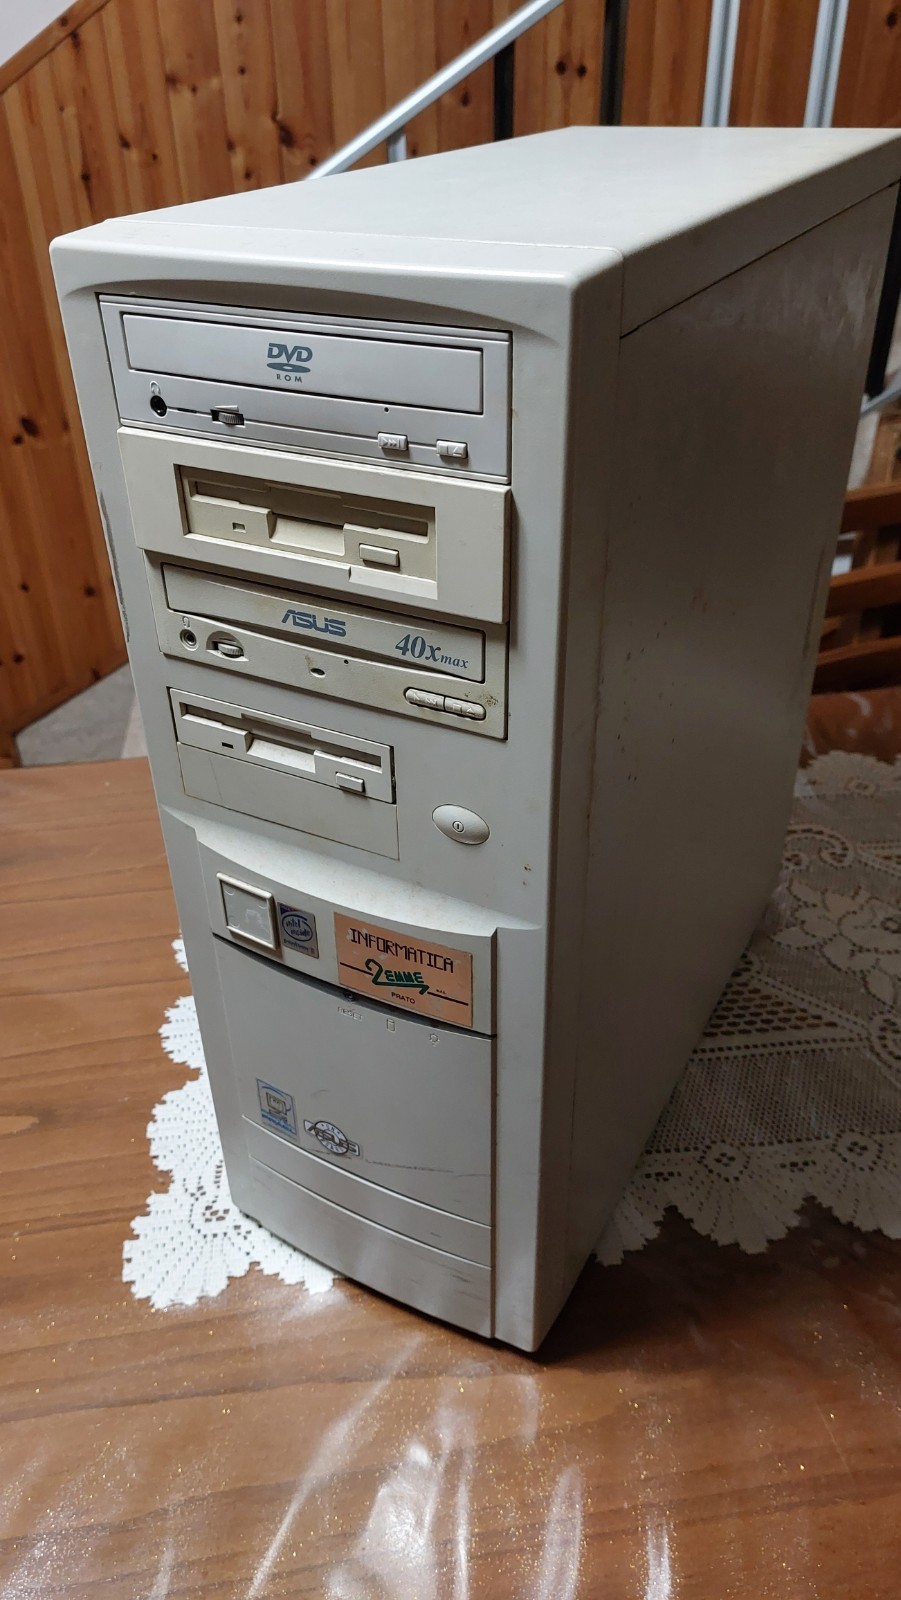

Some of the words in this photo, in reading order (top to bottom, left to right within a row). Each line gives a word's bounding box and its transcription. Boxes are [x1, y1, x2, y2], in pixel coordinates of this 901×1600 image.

[267, 342, 313, 364] DVD
[276, 373, 303, 383] ROM
[281, 609, 347, 637] ASUS
[349, 927, 454, 974] INFORMATICA
[391, 991, 416, 1004] PRATO
